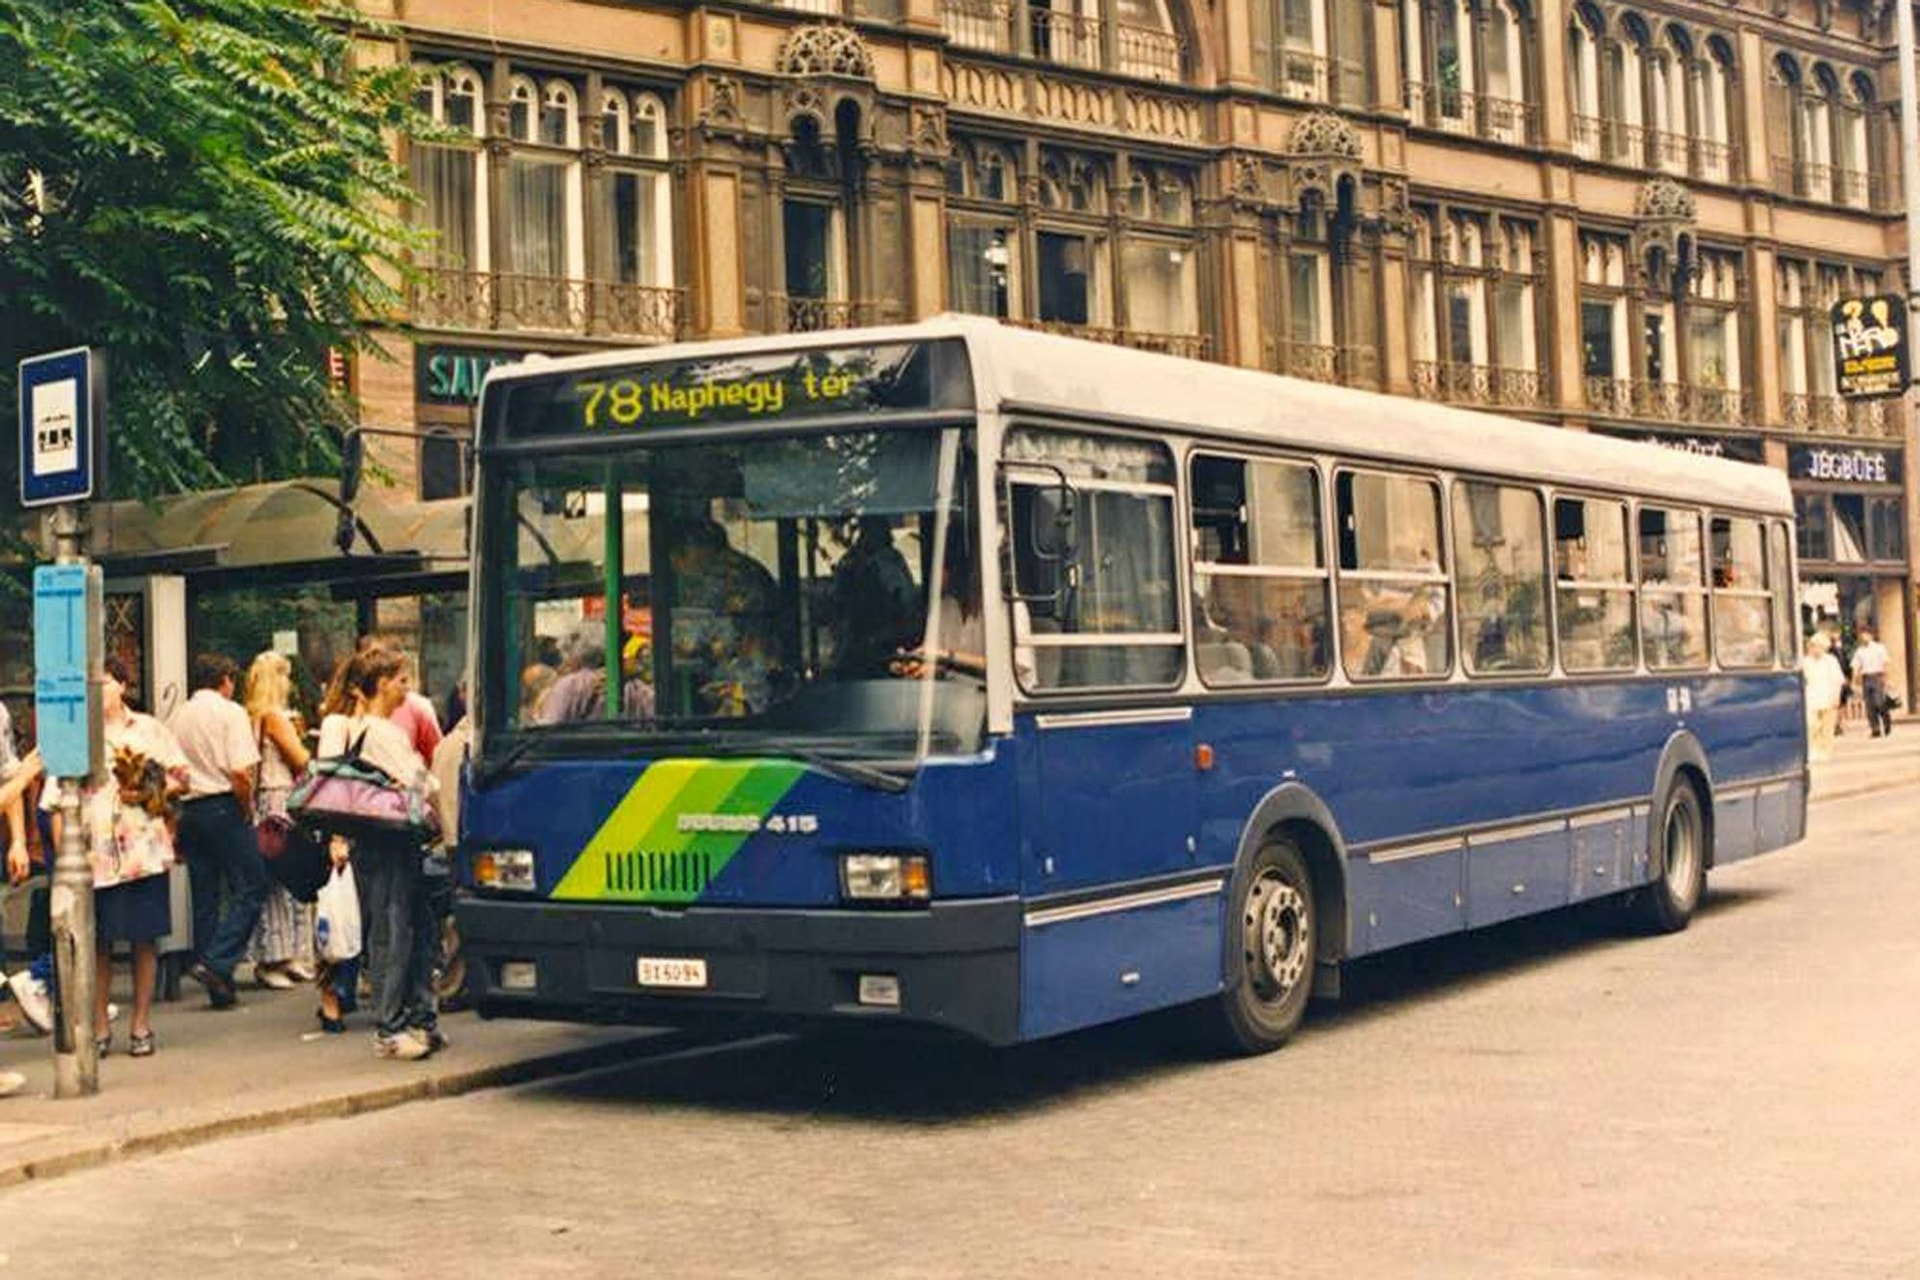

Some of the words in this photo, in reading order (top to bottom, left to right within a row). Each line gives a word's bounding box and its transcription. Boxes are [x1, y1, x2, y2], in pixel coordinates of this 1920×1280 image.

[576, 381, 643, 426] 78
[650, 375, 784, 418] Naphegy
[766, 814, 819, 833] 415
